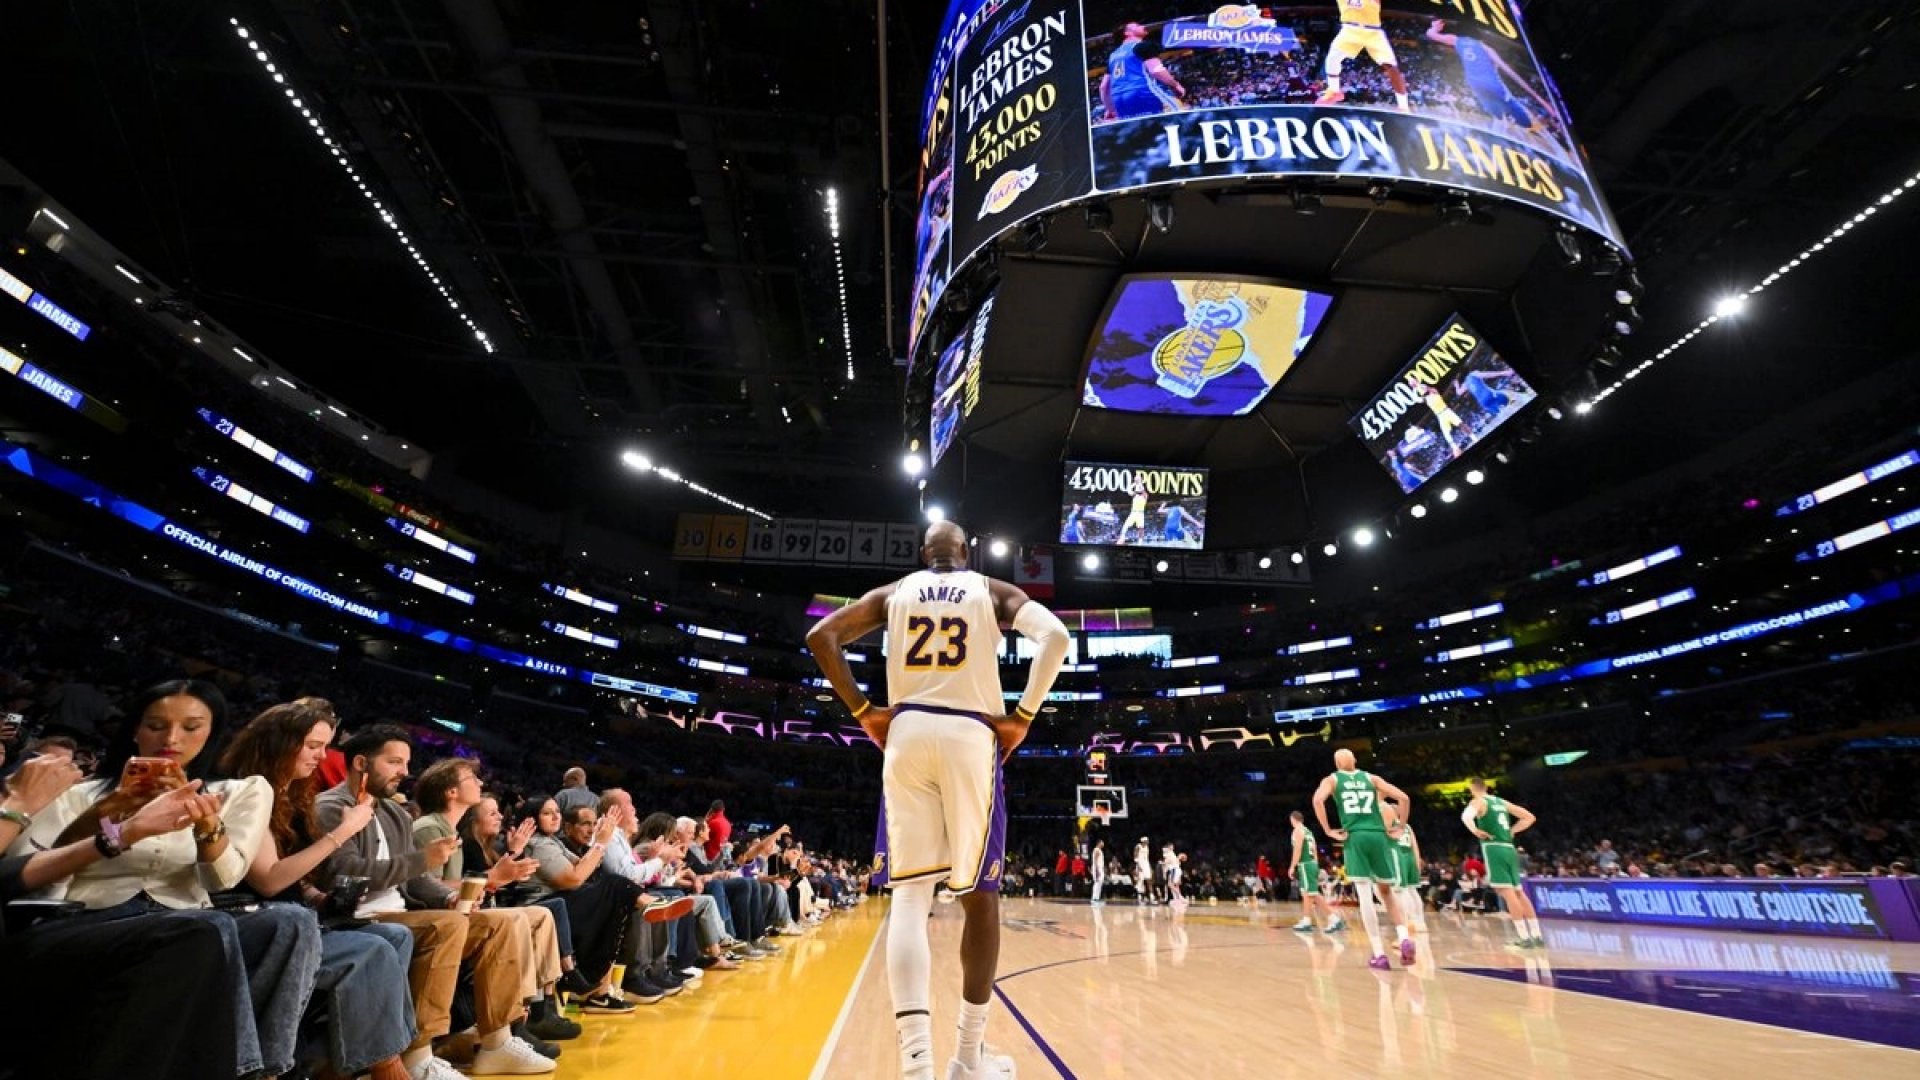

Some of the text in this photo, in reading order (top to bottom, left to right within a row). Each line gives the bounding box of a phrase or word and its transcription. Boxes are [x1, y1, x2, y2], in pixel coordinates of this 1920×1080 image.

[1174, 28, 1283, 45] LEBRON JAMES
[960, 10, 1066, 113] LEBRON
[966, 45, 1053, 132] JAMES
[965, 83, 1056, 165] 43,000
[975, 120, 1041, 182] POINTS
[1165, 116, 1564, 201] LEBRON JAMES
[33, 299, 81, 334] JAMES
[1163, 302, 1242, 391] LAKERS
[23, 369, 73, 402] JAMES
[1360, 323, 1476, 441] 43,000 POINTS
[216, 418, 234, 435] 23
[210, 475, 229, 492] 23
[1069, 466, 1203, 497] 43,000 POINTS
[717, 531, 737, 550] 16
[751, 533, 773, 551] 18
[784, 534, 811, 553] 99
[820, 536, 846, 555] 20
[860, 538, 873, 556] 4
[890, 540, 914, 559] 23
[163, 524, 379, 621] OFFICIAL AIRLINE OF CRYPTO.COM ARENA
[919, 586, 966, 604] JAMES
[904, 616, 968, 672] 23
[1612, 599, 1850, 668] OFFICIAL AIRLINE OF CRYPTO.COM ARENA
[536, 660, 567, 675] DELTA
[1429, 689, 1464, 702] DELTA
[1341, 791, 1374, 814] 27
[1578, 887, 1612, 913] Pass
[1617, 890, 1677, 916] STREAM
[1675, 891, 1706, 918] LIKE
[1702, 892, 1764, 921] YOU'RE
[1765, 893, 1875, 926] COURTSIDE
